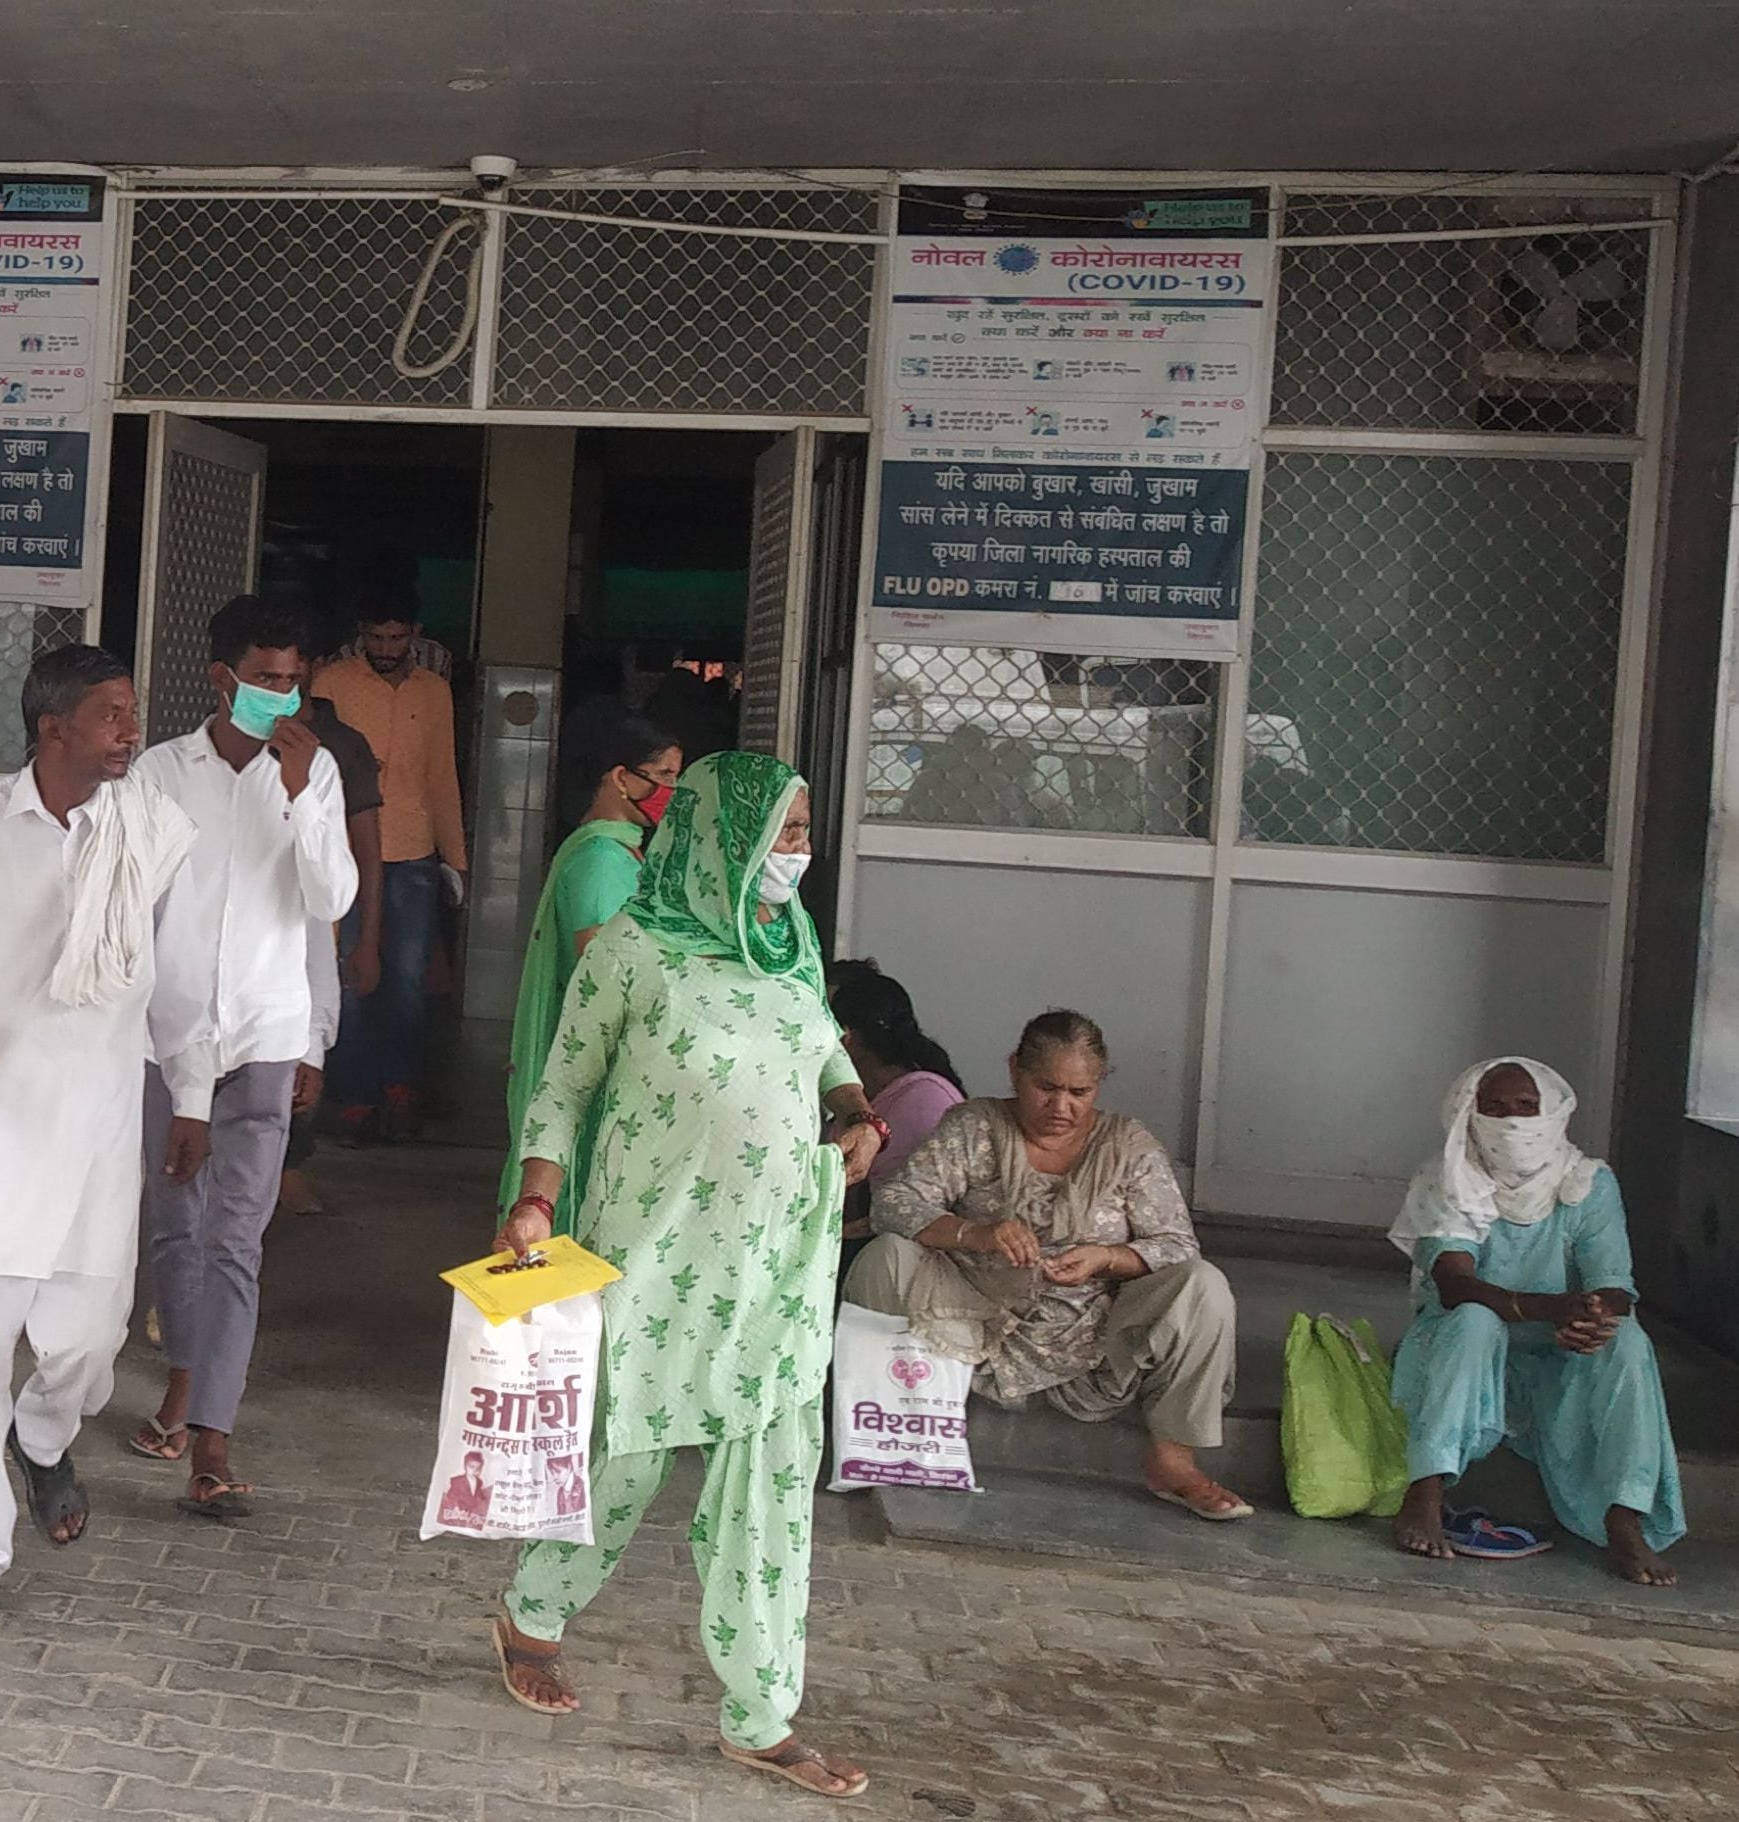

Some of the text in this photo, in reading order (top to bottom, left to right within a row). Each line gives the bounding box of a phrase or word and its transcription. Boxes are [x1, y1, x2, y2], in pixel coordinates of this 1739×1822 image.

[19, 197, 81, 209] help you
[910, 243, 1243, 268] नोवल कोरोनावायरस
[1068, 273, 1245, 294] (COVID-19)
[3, 438, 48, 463] जुखाम
[1, 471, 38, 489] लक्षण
[42, 467, 54, 491] है
[57, 468, 74, 490] तो
[934, 465, 1199, 504] यदि आपको बुखार, खांसी, जुखाम
[23, 499, 43, 521] की
[899, 501, 1230, 535] सांस लेने में दिक्कत से संबंधित लक्षण है तो
[22, 533, 68, 559] करवाएं
[929, 537, 1192, 568] कृपया जिला नागरिक हस्पताल की
[882, 575, 922, 595] FLU
[926, 577, 970, 597] OPD
[974, 579, 1019, 598] कमरा
[1023, 575, 1042, 599] नं.
[1104, 577, 1119, 602] में
[1124, 578, 1162, 604] जांच
[1166, 581, 1223, 609] करवाएं
[852, 1401, 967, 1439] विश्वास
